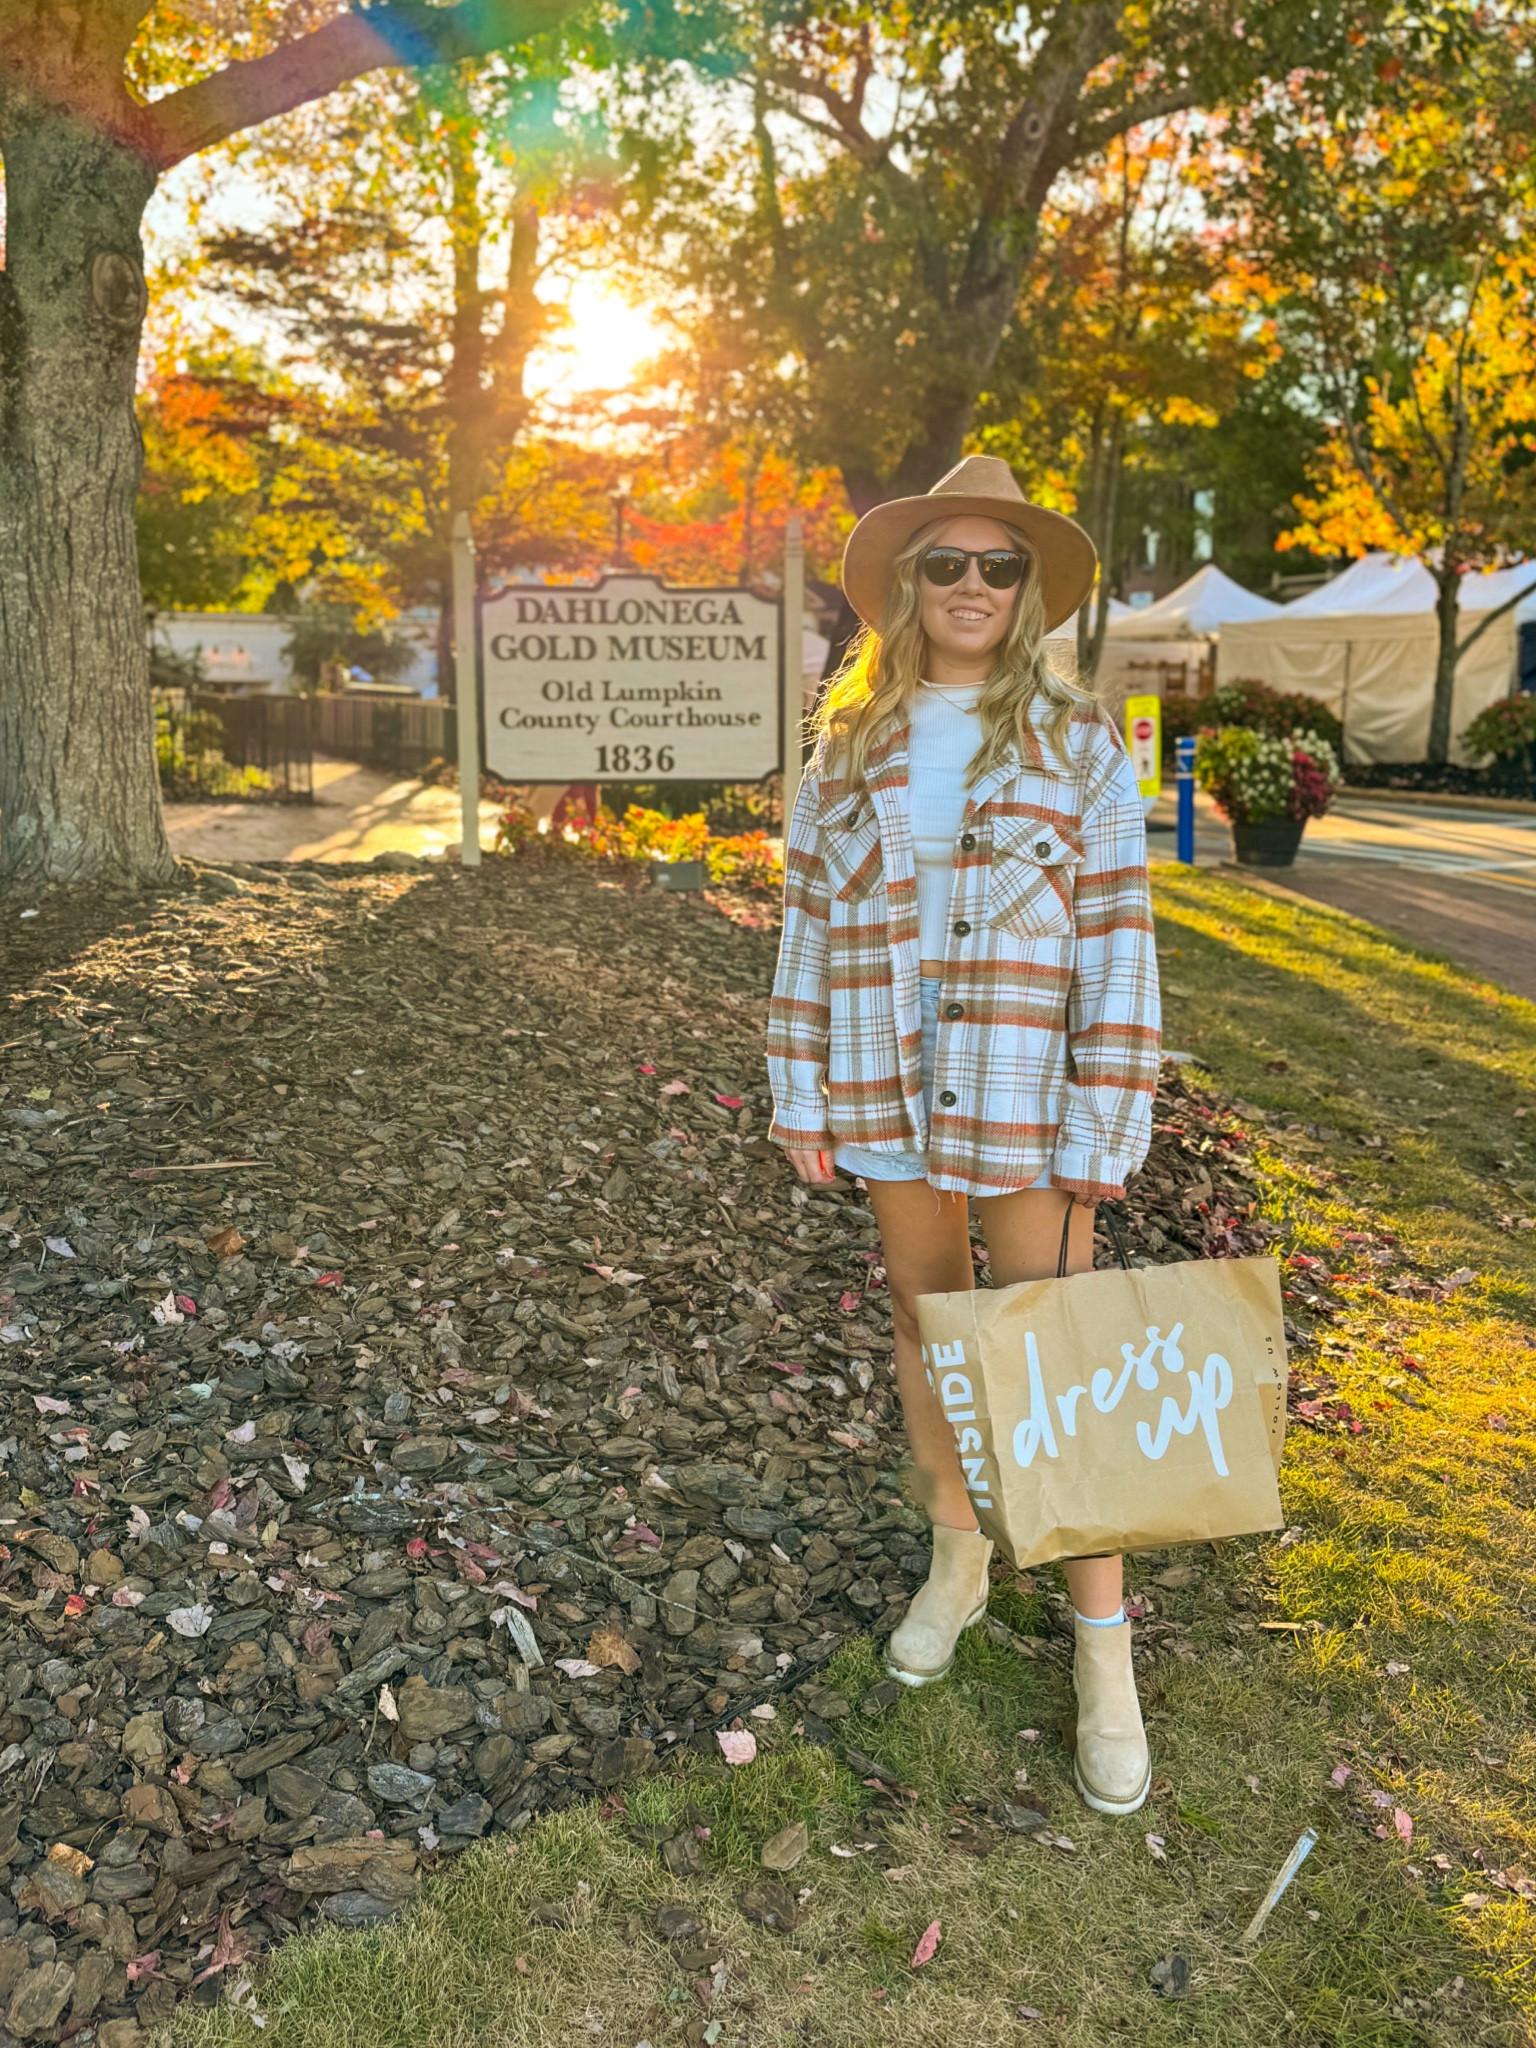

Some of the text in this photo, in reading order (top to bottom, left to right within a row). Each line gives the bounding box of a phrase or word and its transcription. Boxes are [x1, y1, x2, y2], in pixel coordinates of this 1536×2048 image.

[516, 598, 743, 626] DAHLONEGA
[490, 635, 767, 662] GOLD MUSEUM
[541, 681, 722, 707] Old Lumpkin
[499, 708, 761, 735] County Courthouse
[596, 745, 675, 772] 1836
[1013, 1323, 1184, 1467] dress
[1266, 1336, 1282, 1433] FOLLOW US
[931, 1340, 993, 1509] INSIDE
[1136, 1354, 1234, 1477] up
